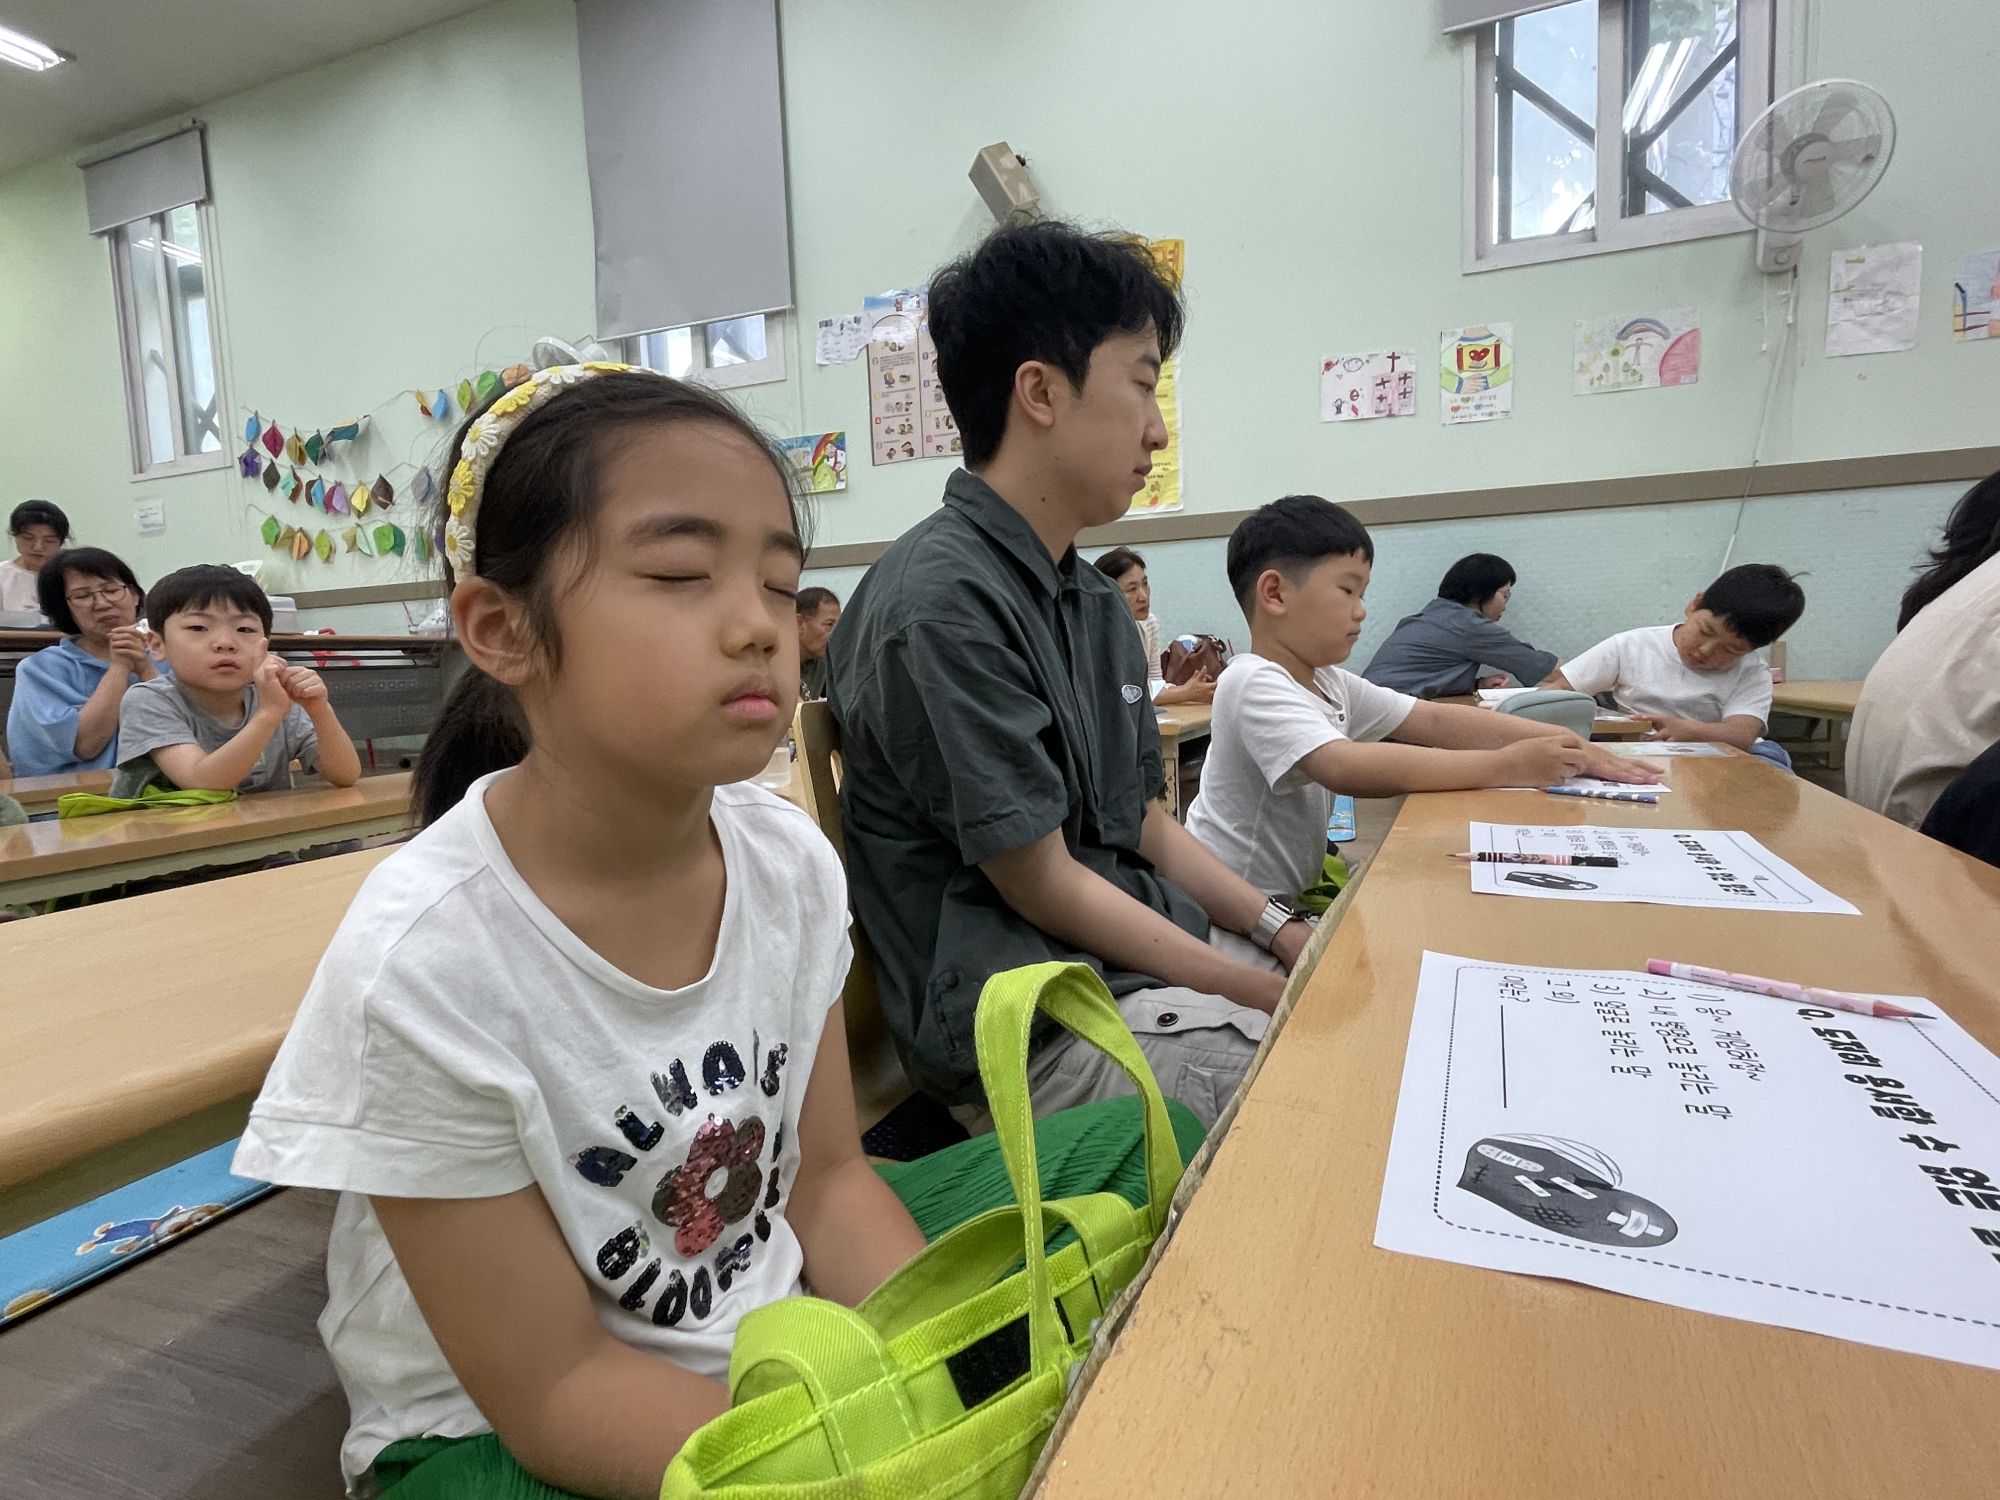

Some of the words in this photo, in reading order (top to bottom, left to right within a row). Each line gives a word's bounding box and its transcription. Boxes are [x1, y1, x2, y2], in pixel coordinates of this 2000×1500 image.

[1500, 976, 1530, 1002] 이유는?
[1545, 991, 1579, 1003] 외)
[1591, 984, 1625, 994] 3)
[1640, 989, 1675, 1000] 2)
[1594, 1001, 1629, 1023] 얼굴로
[1650, 1006, 1677, 1015] 내
[1797, 1007, 1836, 1020] Q.
[1602, 1031, 1642, 1057] 놀리는
[1651, 1022, 1697, 1054] 별명으로
[1812, 1027, 1882, 1067] 도저히
[1611, 1066, 1651, 1078] 말
[1668, 1063, 1717, 1094] 놀리는
[1844, 1074, 1936, 1125] 용서할
[1685, 1105, 1731, 1119] 말
[1899, 1134, 1960, 1153] 수
